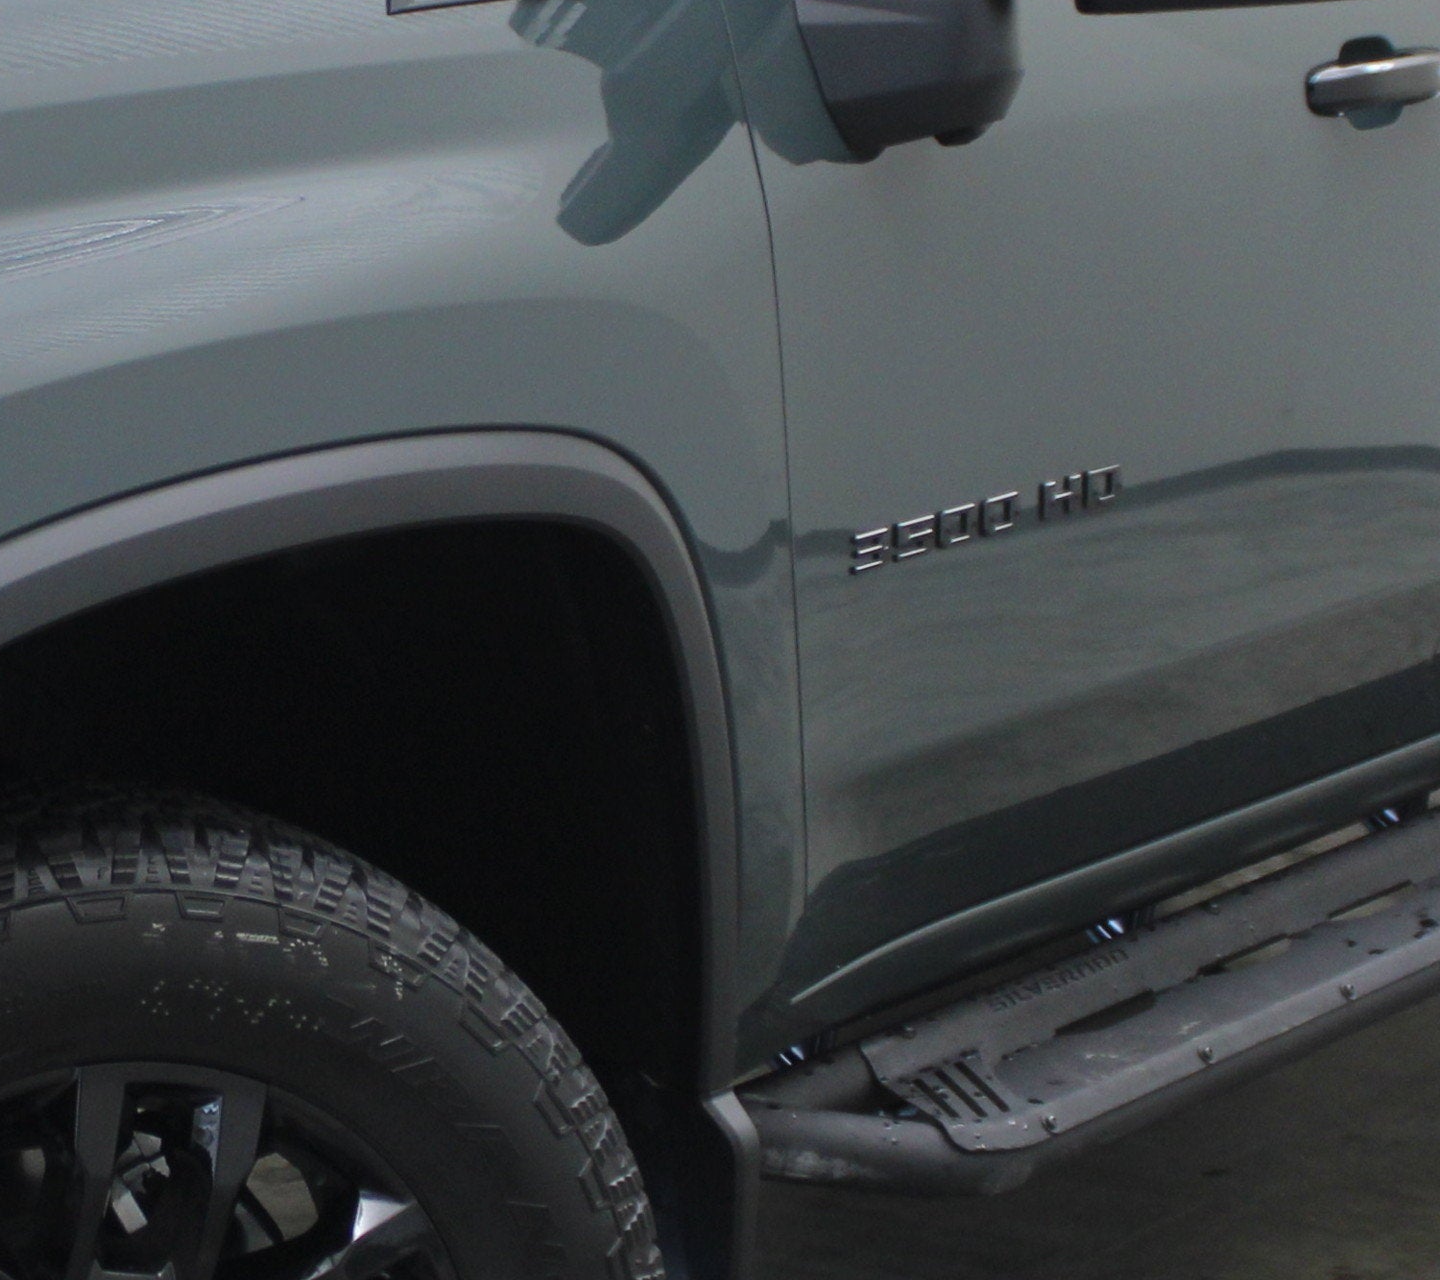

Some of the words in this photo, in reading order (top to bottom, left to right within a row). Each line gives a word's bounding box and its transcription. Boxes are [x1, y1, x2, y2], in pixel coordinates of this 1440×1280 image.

[848, 491, 1019, 576] 3500
[1036, 464, 1121, 521] HD
[987, 947, 1131, 1013] SILVERADO
